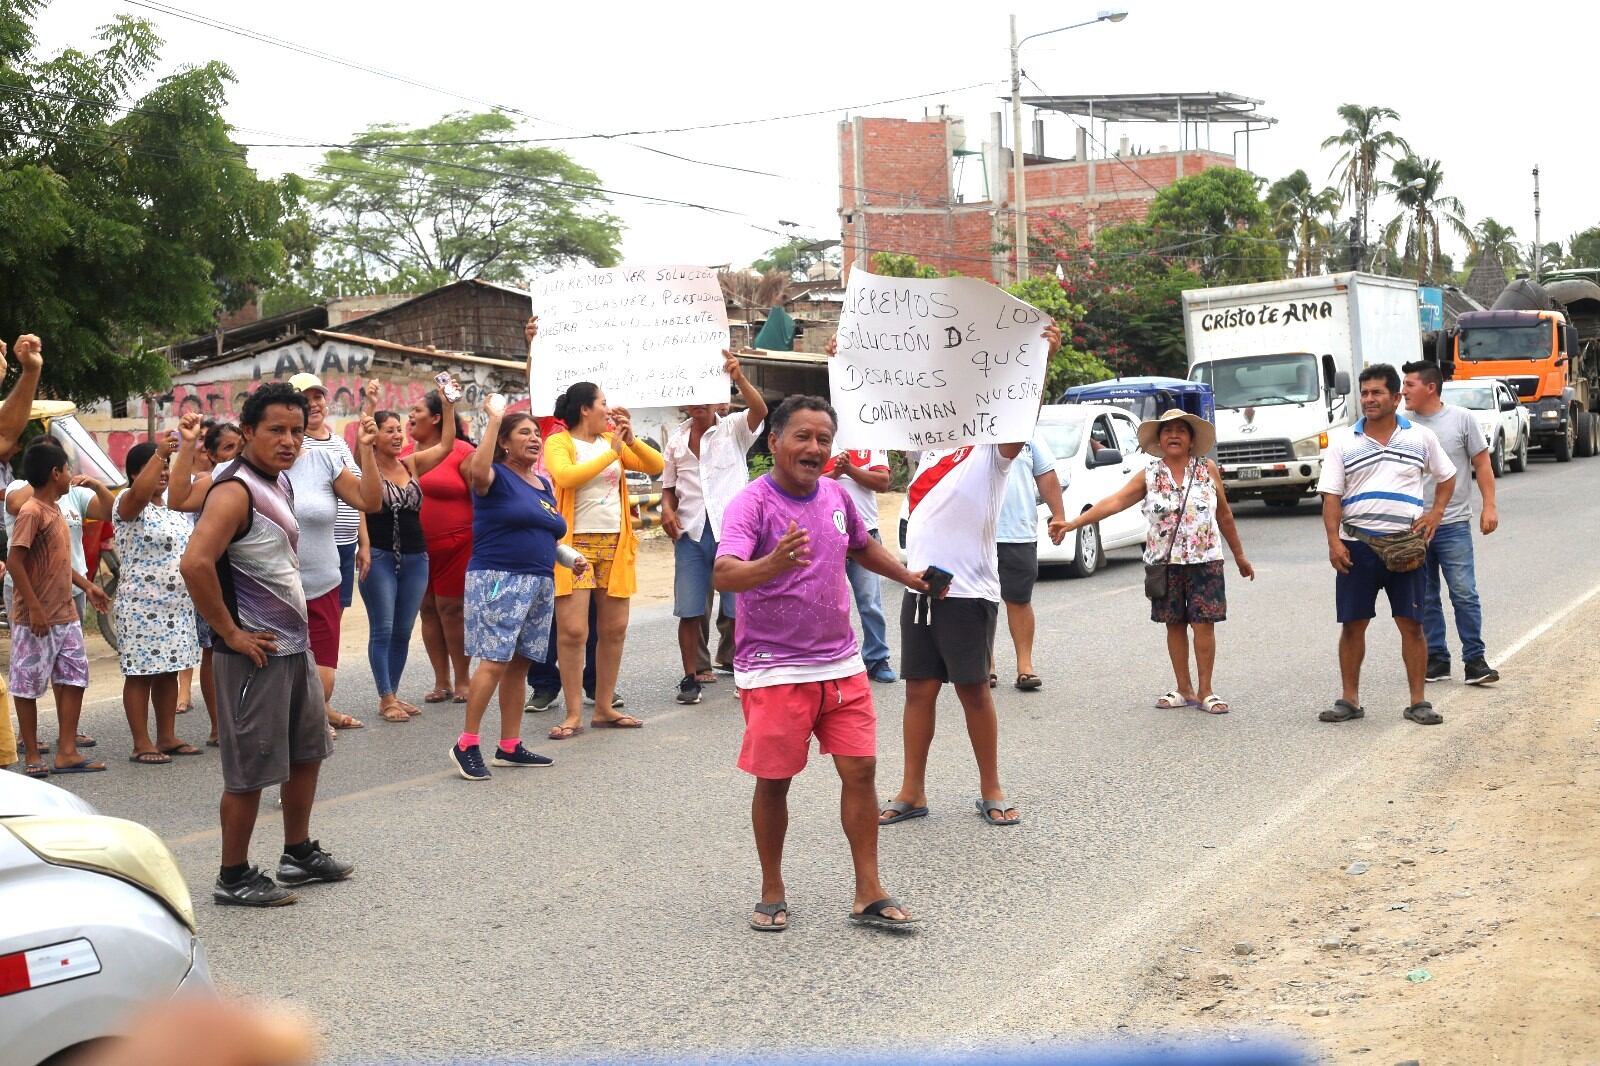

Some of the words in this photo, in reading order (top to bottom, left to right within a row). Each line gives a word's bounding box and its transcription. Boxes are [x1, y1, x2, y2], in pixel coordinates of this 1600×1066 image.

[623, 268, 646, 284] VER
[1282, 301, 1333, 326] AMA
[840, 321, 930, 352] SOLUCIÓN
[944, 322, 981, 349] DE
[996, 304, 1040, 330] LOS
[840, 364, 947, 392] DESAGUES
[908, 412, 999, 446] AMBIENTE
